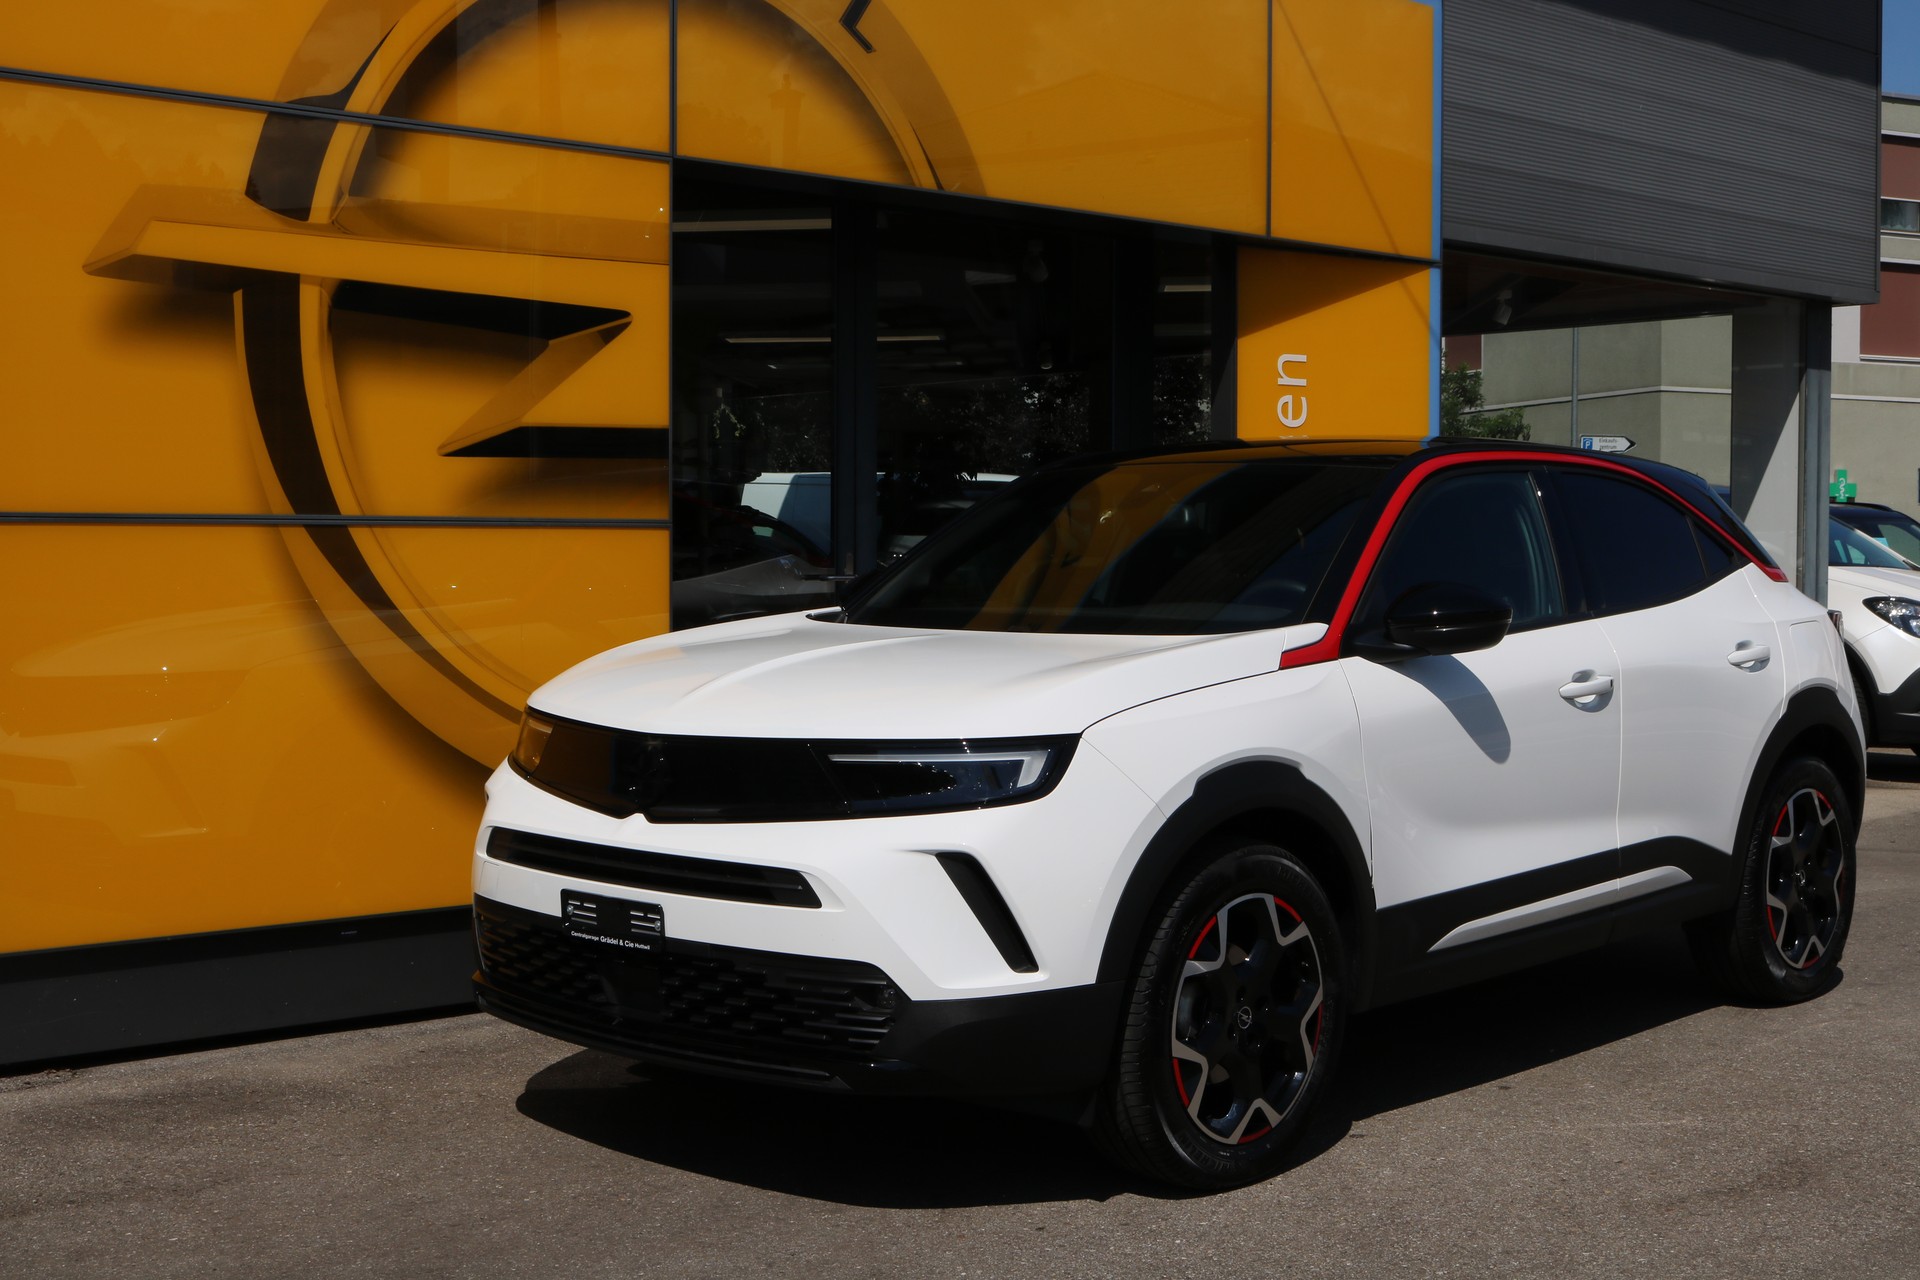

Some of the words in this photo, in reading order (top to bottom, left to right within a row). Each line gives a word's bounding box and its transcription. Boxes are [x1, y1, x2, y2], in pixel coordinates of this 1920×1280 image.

[1277, 354, 1308, 438] en
[571, 930, 599, 941] Centralgarage
[600, 935, 618, 945] Grädel
[624, 940, 634, 948] Cie
[634, 942, 650, 950] Huttwil
